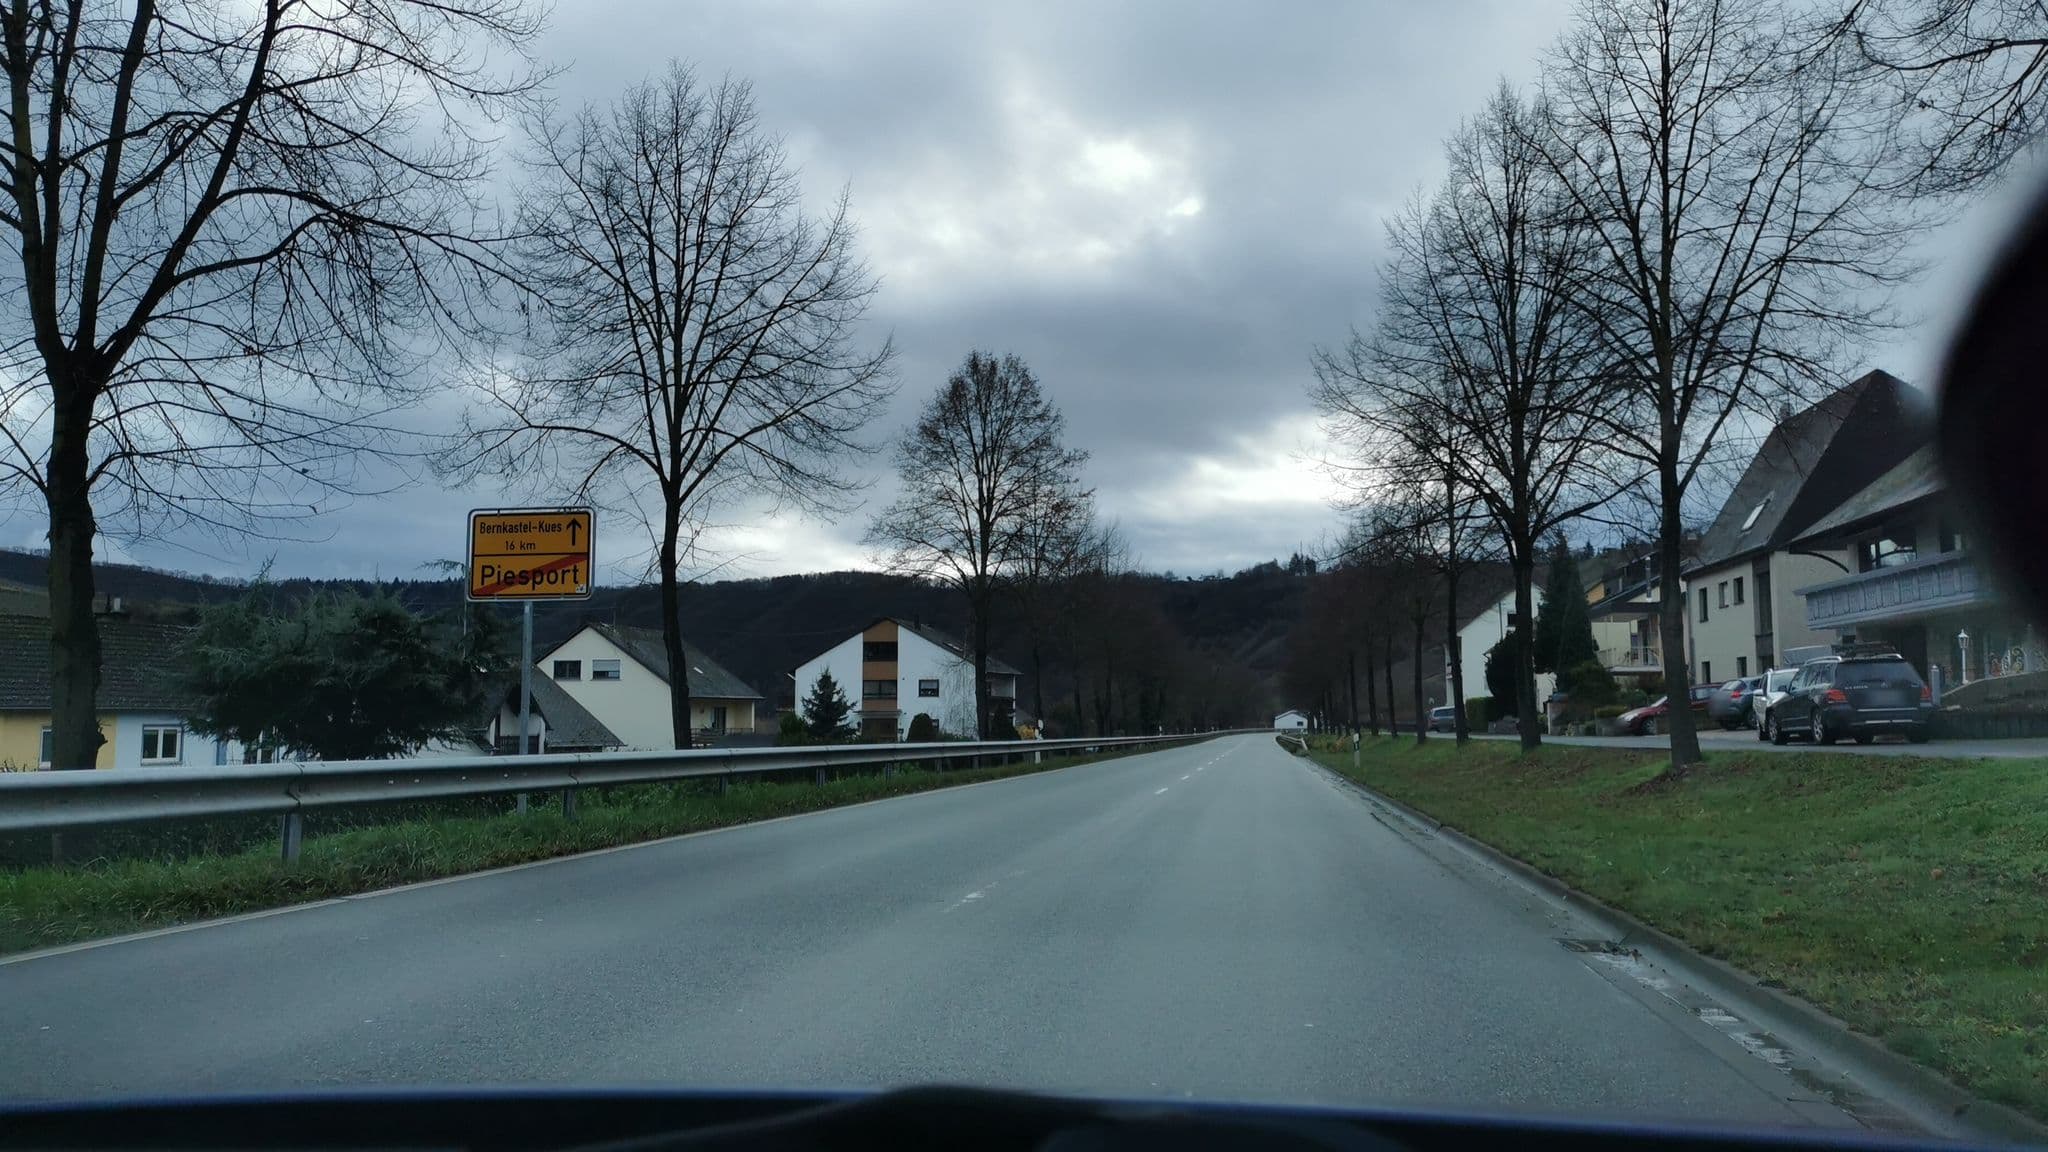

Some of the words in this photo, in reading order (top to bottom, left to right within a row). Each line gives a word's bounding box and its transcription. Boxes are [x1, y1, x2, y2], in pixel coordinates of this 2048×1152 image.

[479, 521, 562, 534] Bernkastel-Kues
[505, 541, 515, 551] 16
[519, 541, 536, 551] km
[480, 564, 580, 591] Piesport
